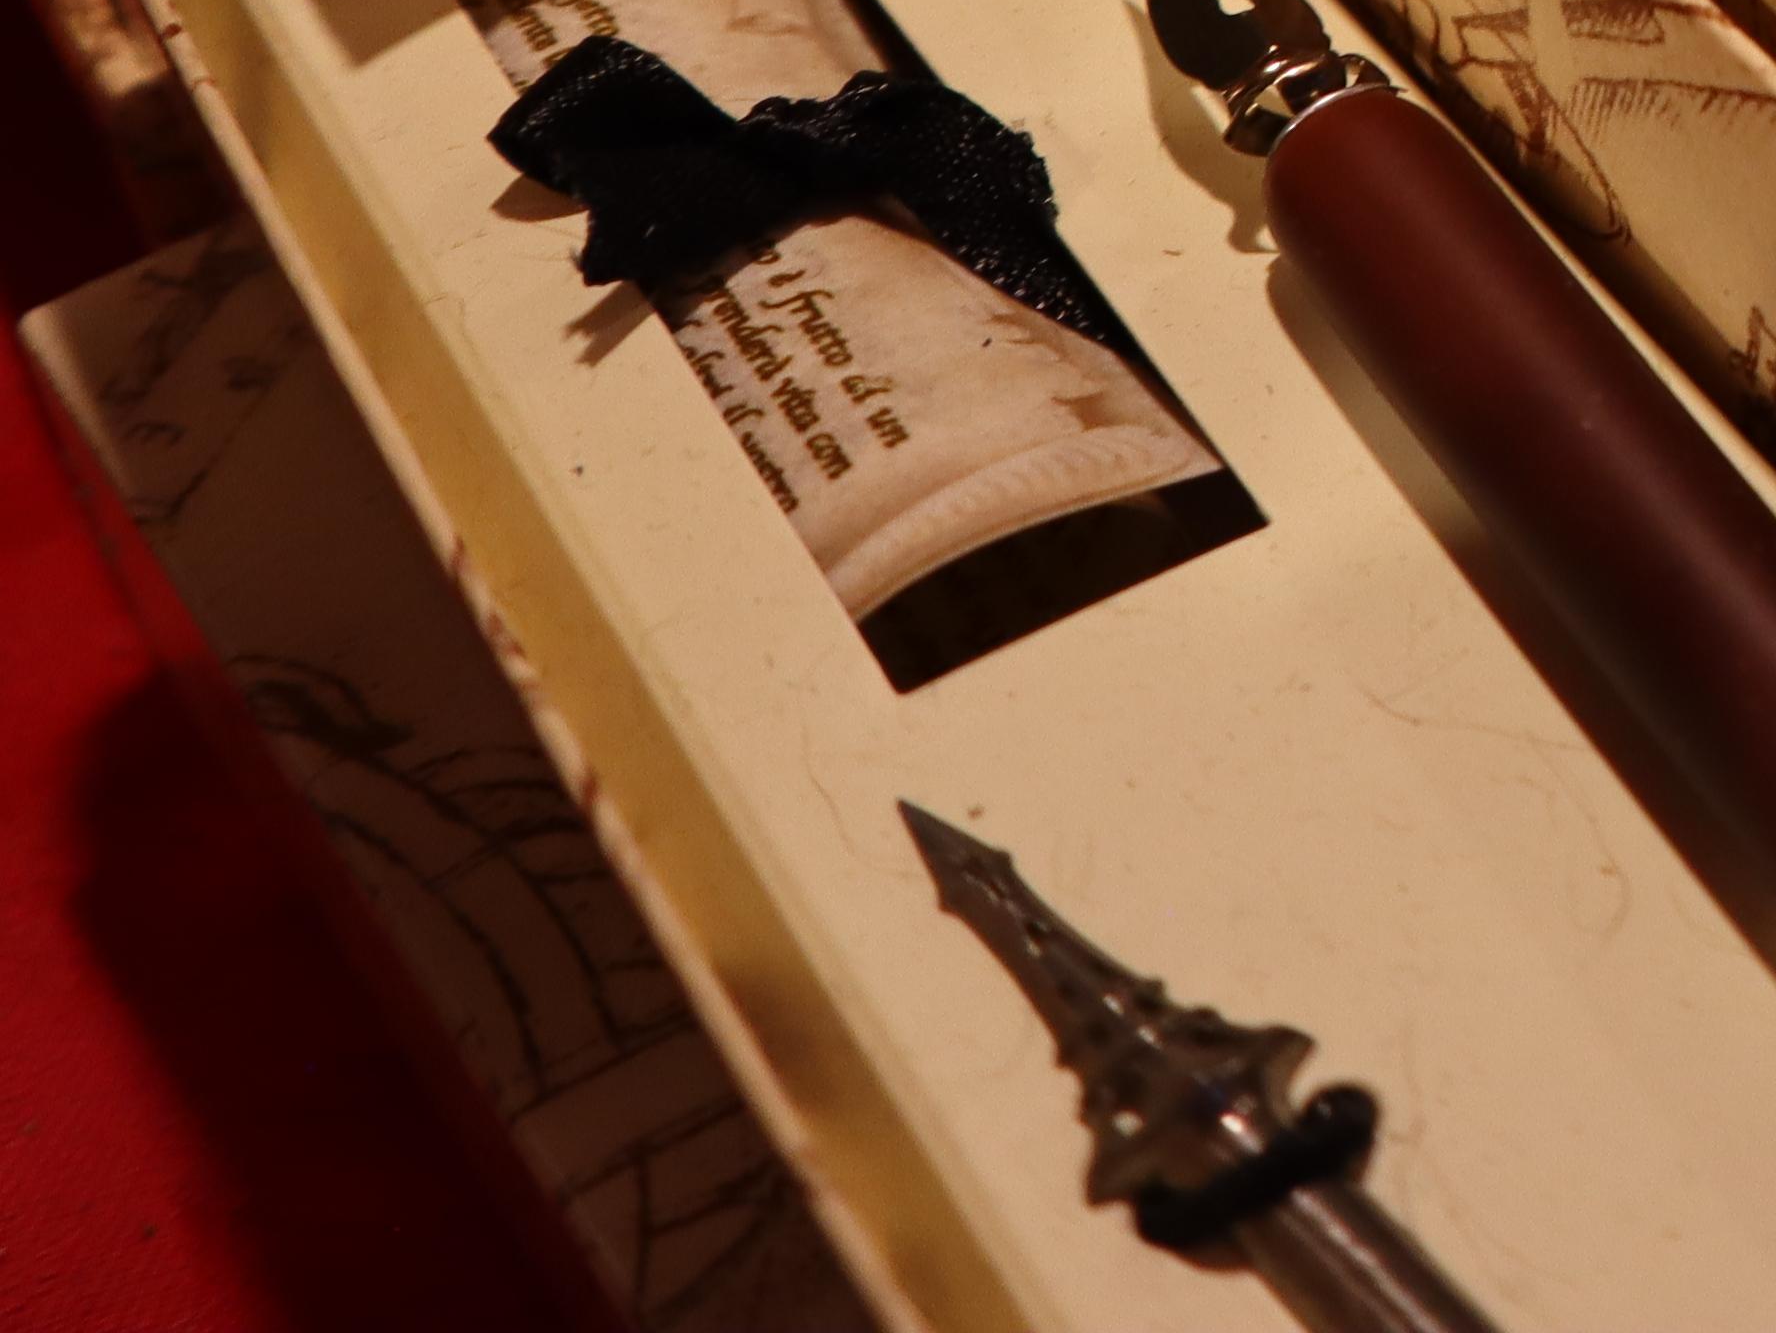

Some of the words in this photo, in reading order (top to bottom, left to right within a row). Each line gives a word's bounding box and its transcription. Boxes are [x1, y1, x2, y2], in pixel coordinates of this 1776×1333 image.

[758, 288, 854, 368] frutto
[865, 406, 912, 450] un
[769, 376, 821, 435] vita
[804, 432, 854, 481] con
